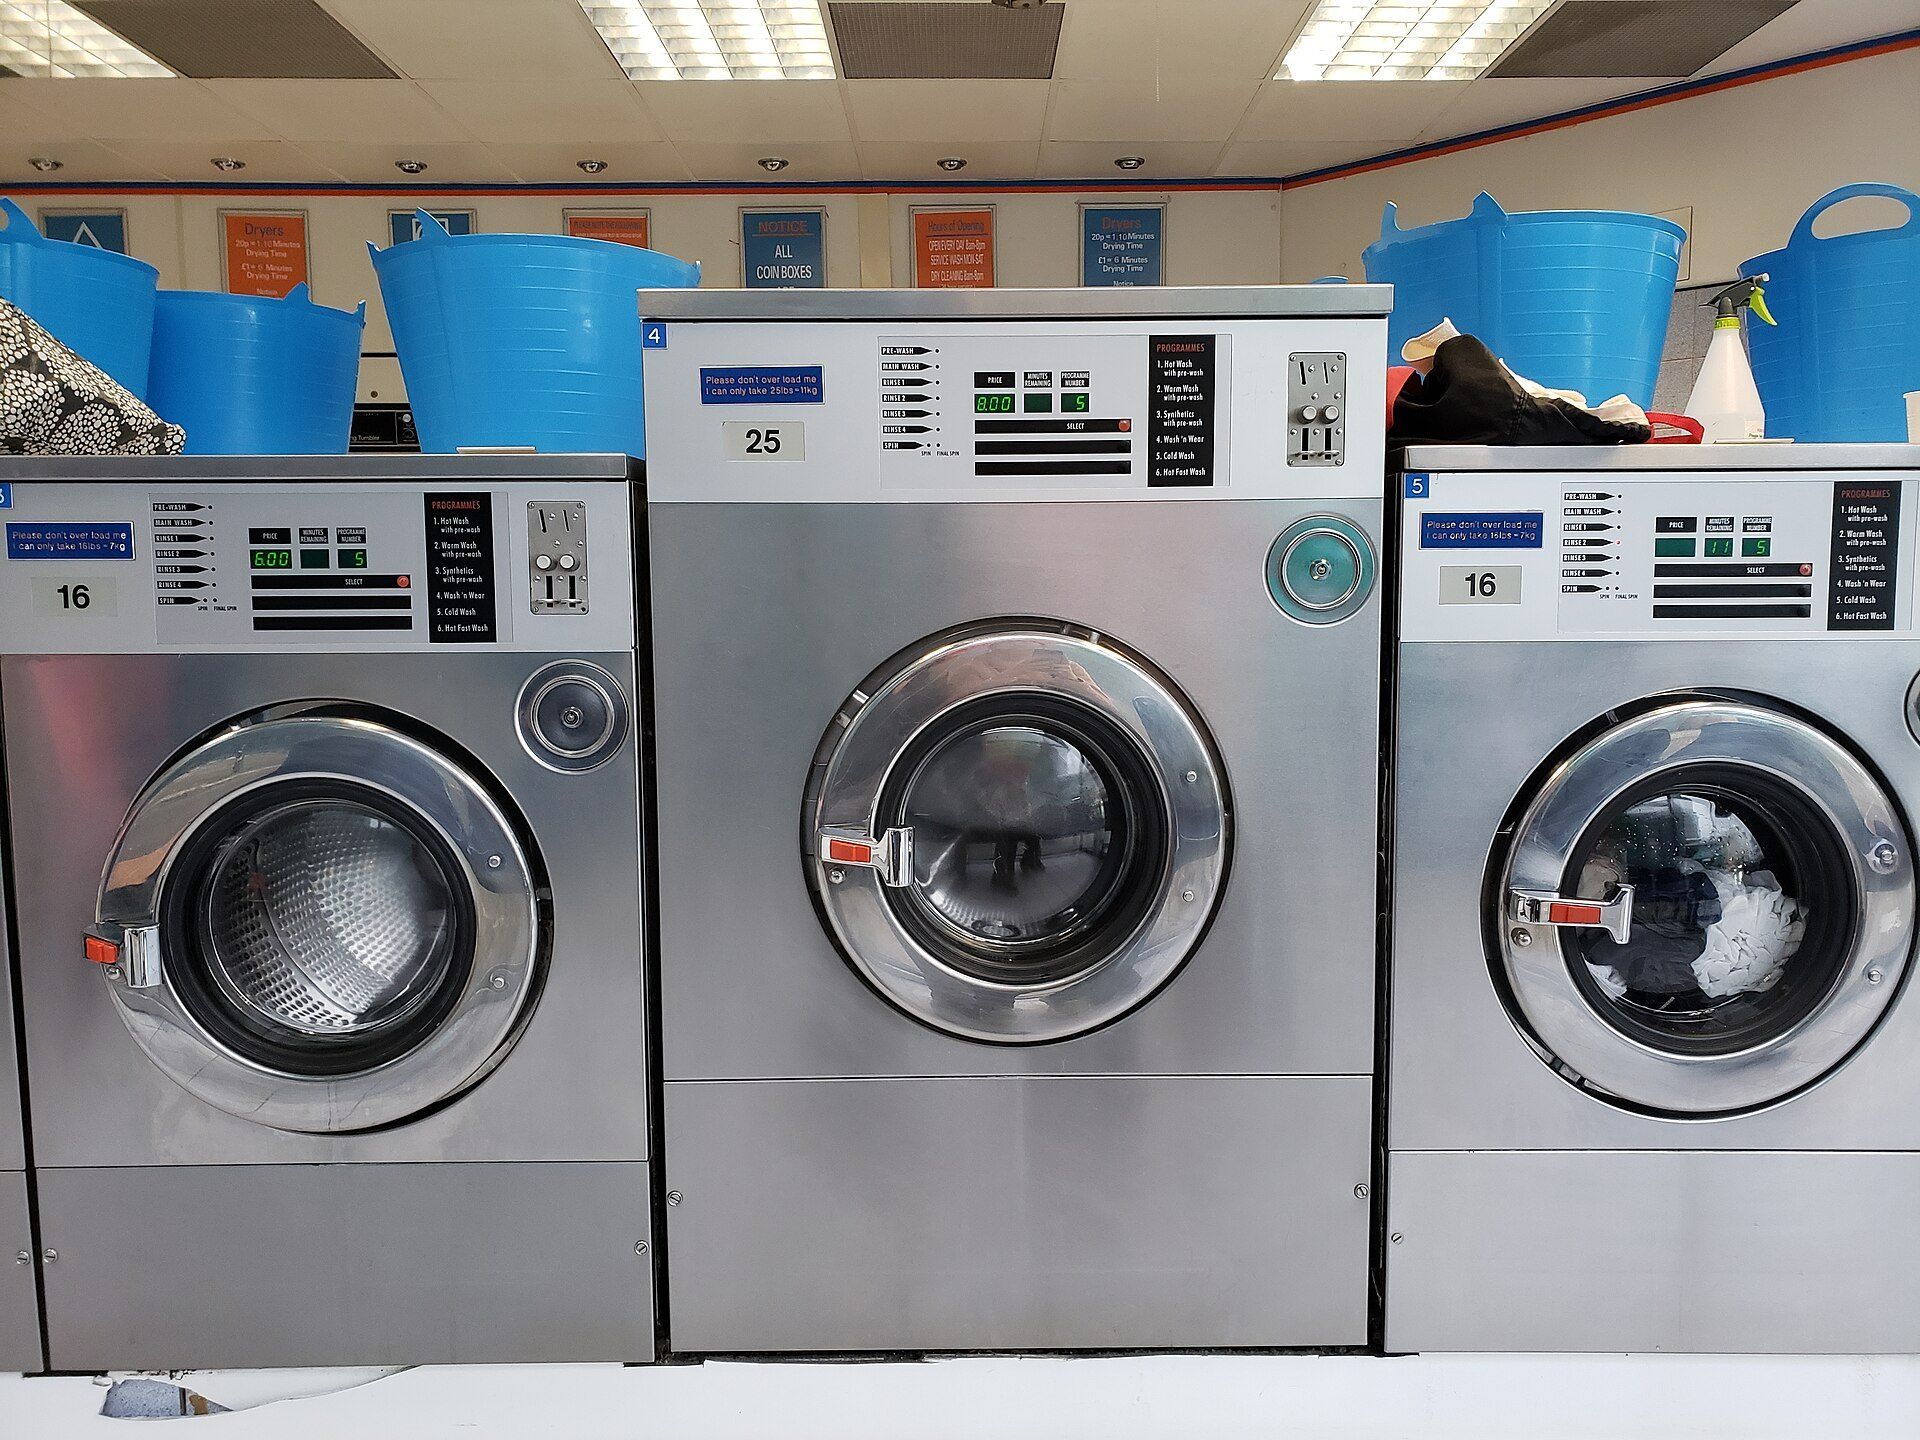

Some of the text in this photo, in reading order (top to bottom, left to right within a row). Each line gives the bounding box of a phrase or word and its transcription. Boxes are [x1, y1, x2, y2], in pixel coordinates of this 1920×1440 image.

[759, 220, 808, 232] NOTICE
[928, 221, 946, 231] Hours
[957, 220, 984, 233] Opening
[1102, 217, 1141, 230] Dryers
[246, 223, 284, 238] Dryers
[775, 244, 793, 258] ALL
[929, 240, 940, 251] OPEN
[956, 240, 964, 250] DAY
[930, 255, 949, 265] SERVICE
[950, 254, 963, 265] WASH
[756, 265, 812, 279] COIN BOXES
[931, 270, 940, 281] DRY
[941, 270, 963, 281] CLEANING
[648, 328, 660, 344] 4
[1156, 344, 1205, 352] PROGRAMMES
[1176, 360, 1192, 368] Wash
[1178, 369, 1204, 378] pre-wash
[706, 376, 734, 384] Please
[738, 376, 759, 384] don't
[782, 375, 800, 383] load
[730, 387, 747, 397] only
[1183, 384, 1199, 392] Wash
[1076, 396, 1085, 410] 5
[1177, 393, 1203, 402] pre-wash
[977, 397, 1011, 411] 8.00
[1164, 410, 1194, 419] Synthetics
[1177, 418, 1202, 428] pre-wash
[745, 429, 781, 454] 25
[1164, 452, 1177, 460] Cold
[1179, 452, 1194, 460] Wash
[1190, 468, 1206, 476] Wash
[1412, 478, 1423, 494] 5
[1841, 489, 1890, 498] PROGRAMMES
[432, 501, 480, 510] PROGRAMMES
[1450, 532, 1466, 540] only
[1520, 532, 1535, 540] 7kg
[37, 543, 54, 551] only
[110, 543, 125, 551] 7kg
[1712, 541, 1728, 553] 11
[1757, 540, 1766, 554] 5
[254, 552, 288, 566] 6.00
[355, 552, 363, 566] 5
[1465, 572, 1496, 597] 16
[57, 585, 90, 609] 16
